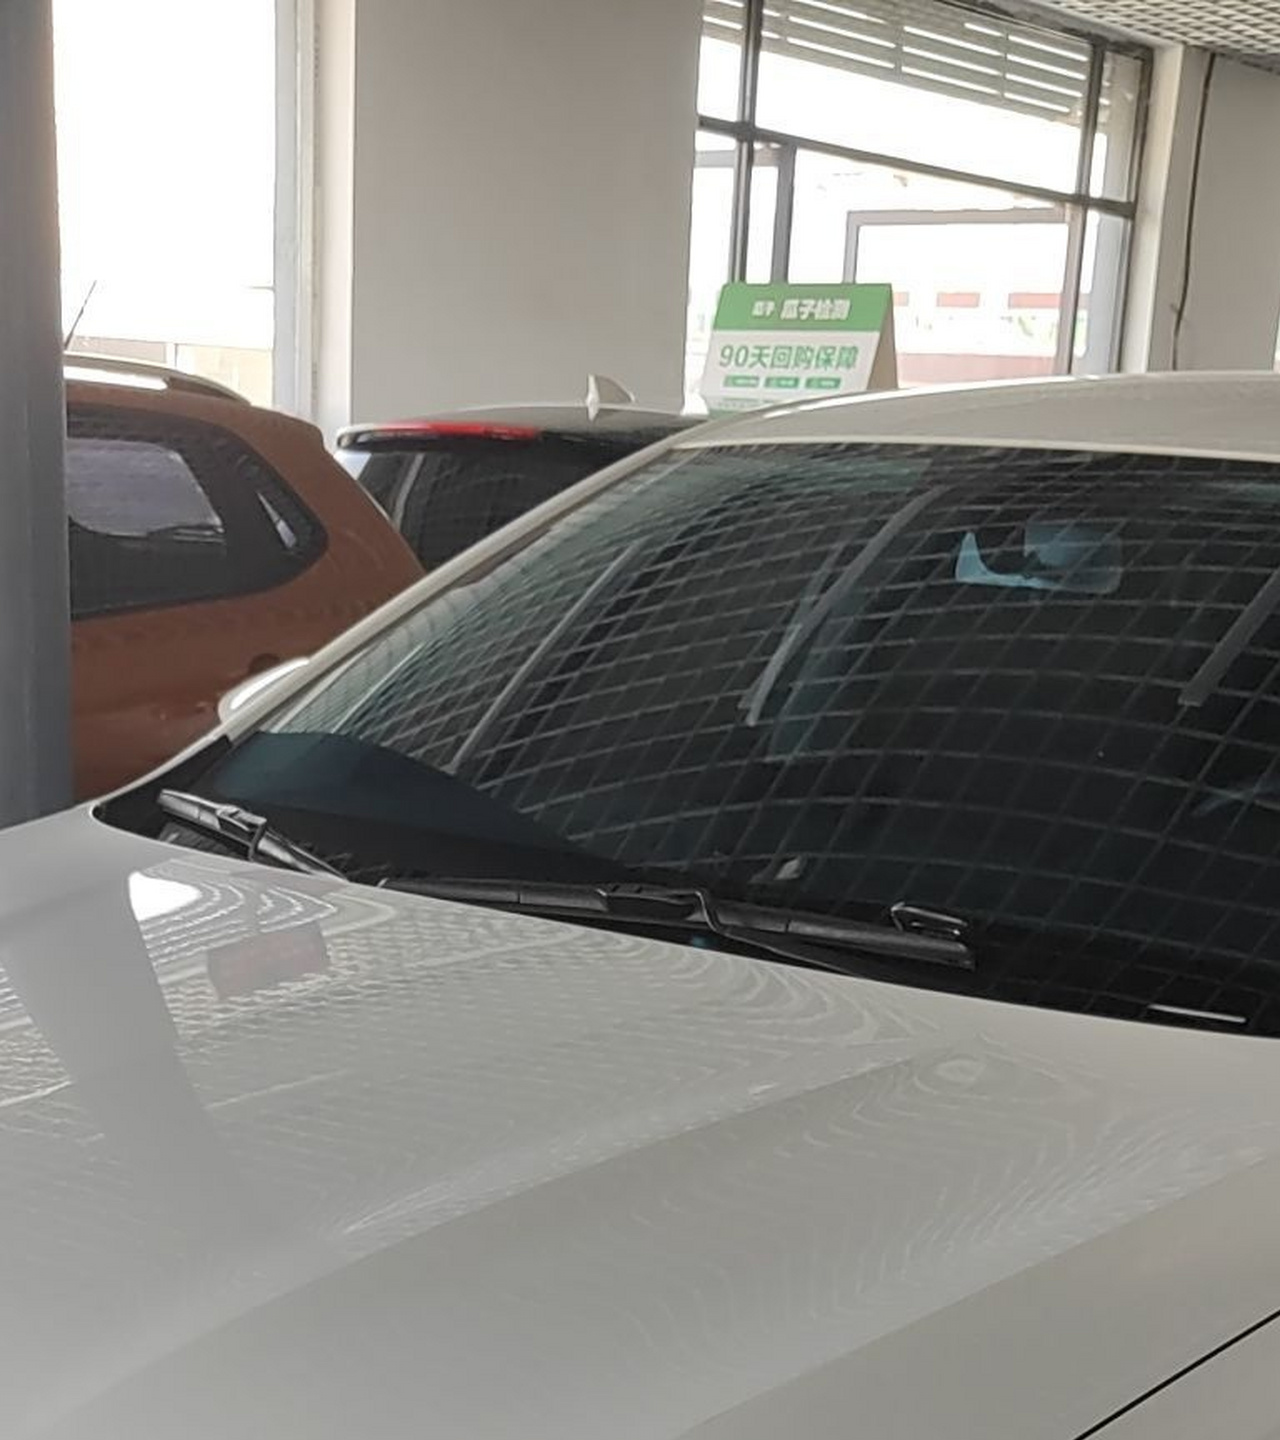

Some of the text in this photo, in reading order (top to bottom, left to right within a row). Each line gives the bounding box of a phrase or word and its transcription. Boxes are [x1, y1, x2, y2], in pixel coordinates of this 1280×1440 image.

[780, 298, 851, 321] 瓜子检测
[719, 344, 859, 371] 90天回购保障
